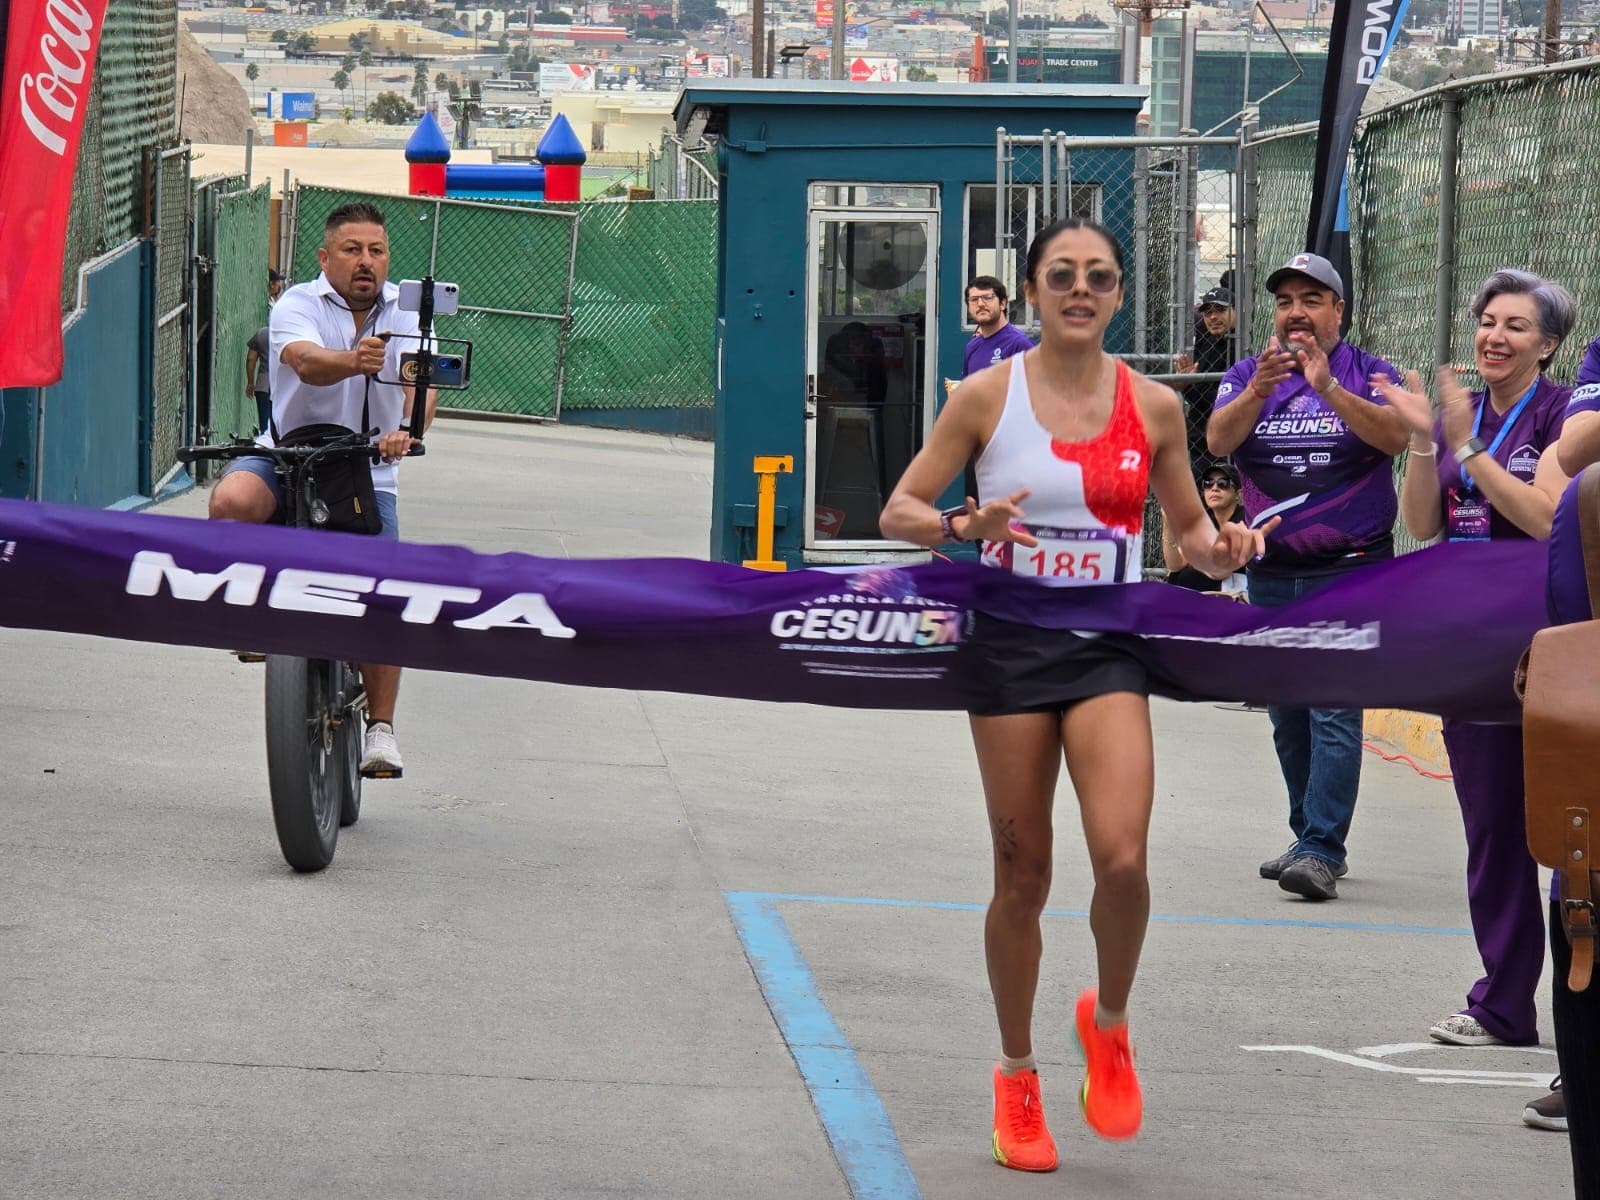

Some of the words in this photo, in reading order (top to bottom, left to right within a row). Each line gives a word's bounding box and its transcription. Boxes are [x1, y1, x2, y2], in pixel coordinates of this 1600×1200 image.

[20, 0, 93, 156] Coca
[1046, 58, 1069, 66] TRADE
[1070, 59, 1098, 67] CENTER
[1254, 416, 1345, 435] CESUN5K
[1029, 549, 1102, 581] 185
[125, 549, 577, 639] META
